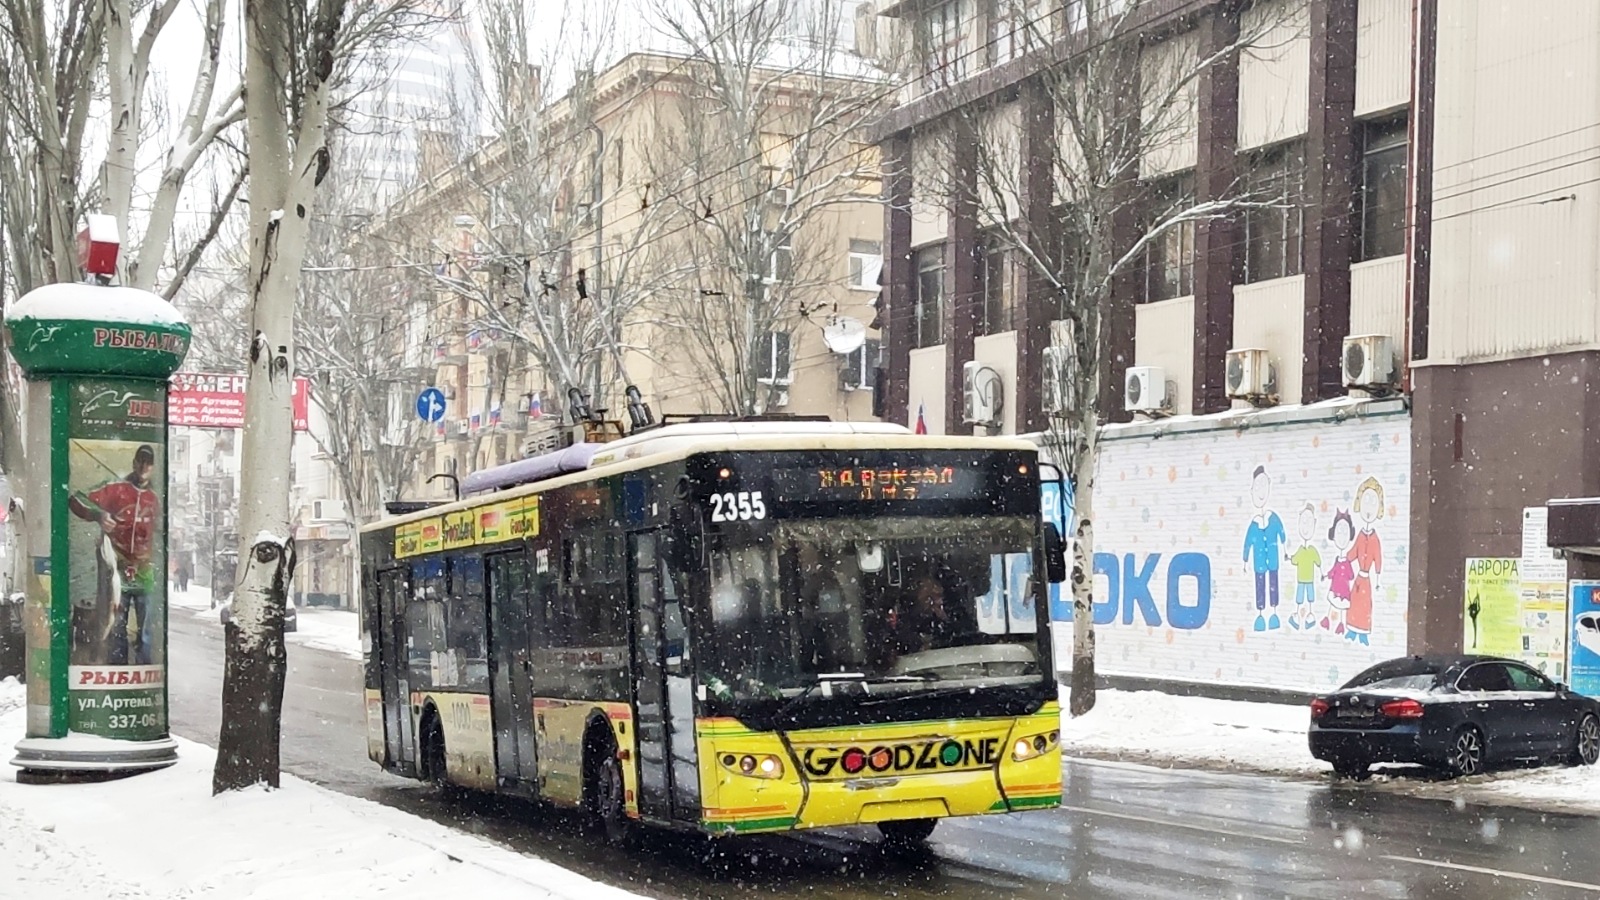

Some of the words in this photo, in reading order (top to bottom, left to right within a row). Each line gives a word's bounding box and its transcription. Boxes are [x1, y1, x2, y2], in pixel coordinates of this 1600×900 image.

[710, 491, 766, 522] 2355
[1468, 559, 1519, 576] АВРОРА
[78, 698, 100, 712] ул.
[804, 737, 999, 776] GOODZONE
